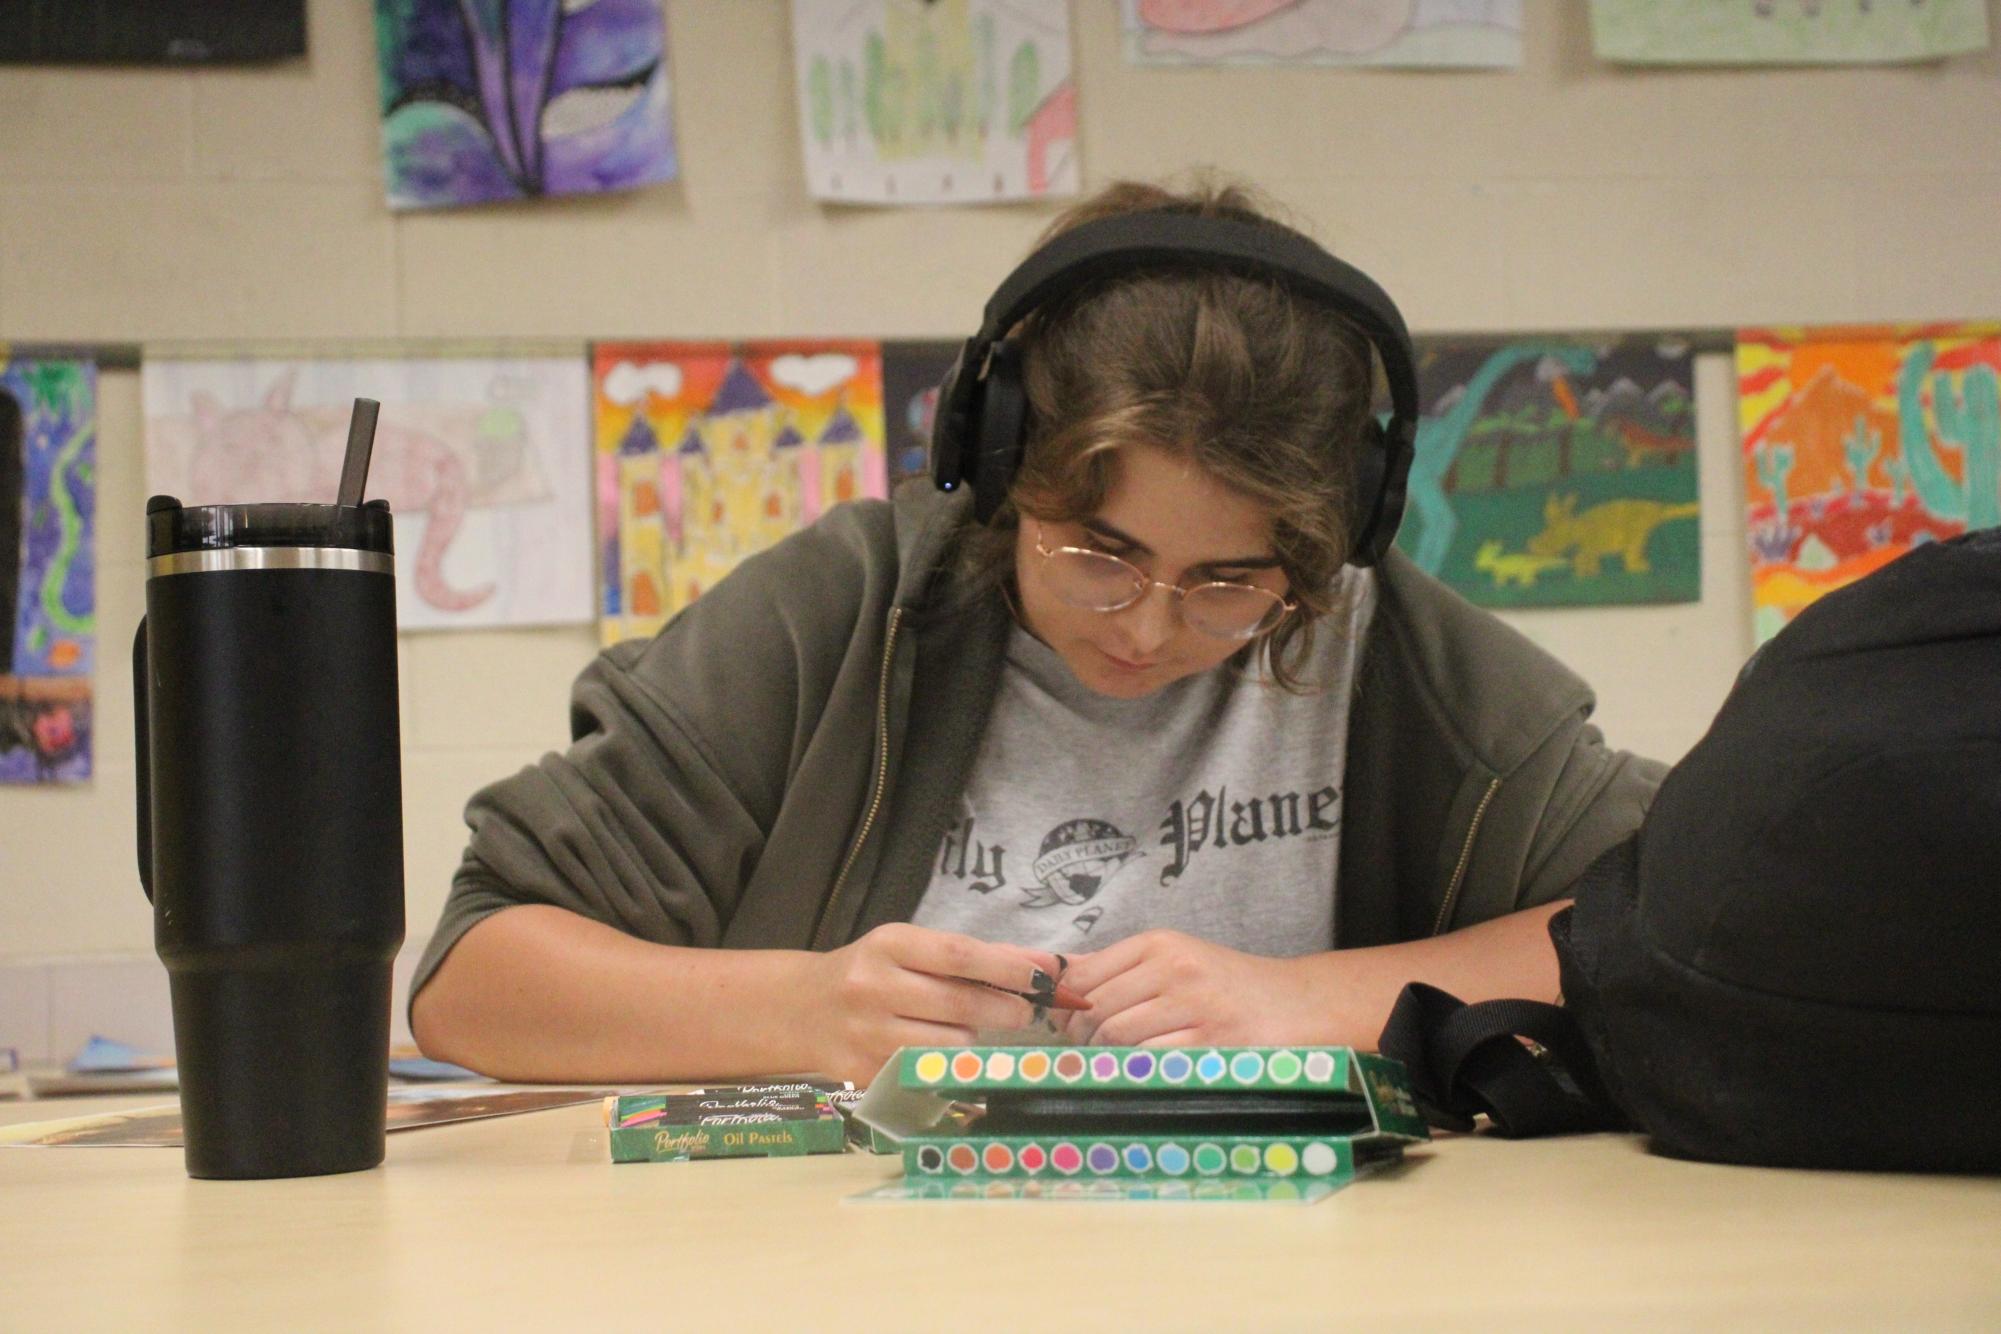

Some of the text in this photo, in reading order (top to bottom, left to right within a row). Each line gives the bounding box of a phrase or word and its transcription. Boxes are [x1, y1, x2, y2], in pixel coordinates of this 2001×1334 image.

[941, 785, 1340, 894] ily Plane
[1037, 850, 1073, 873] DAILY
[654, 1124, 710, 1153] Portfolio
[723, 1131, 745, 1146] Oil
